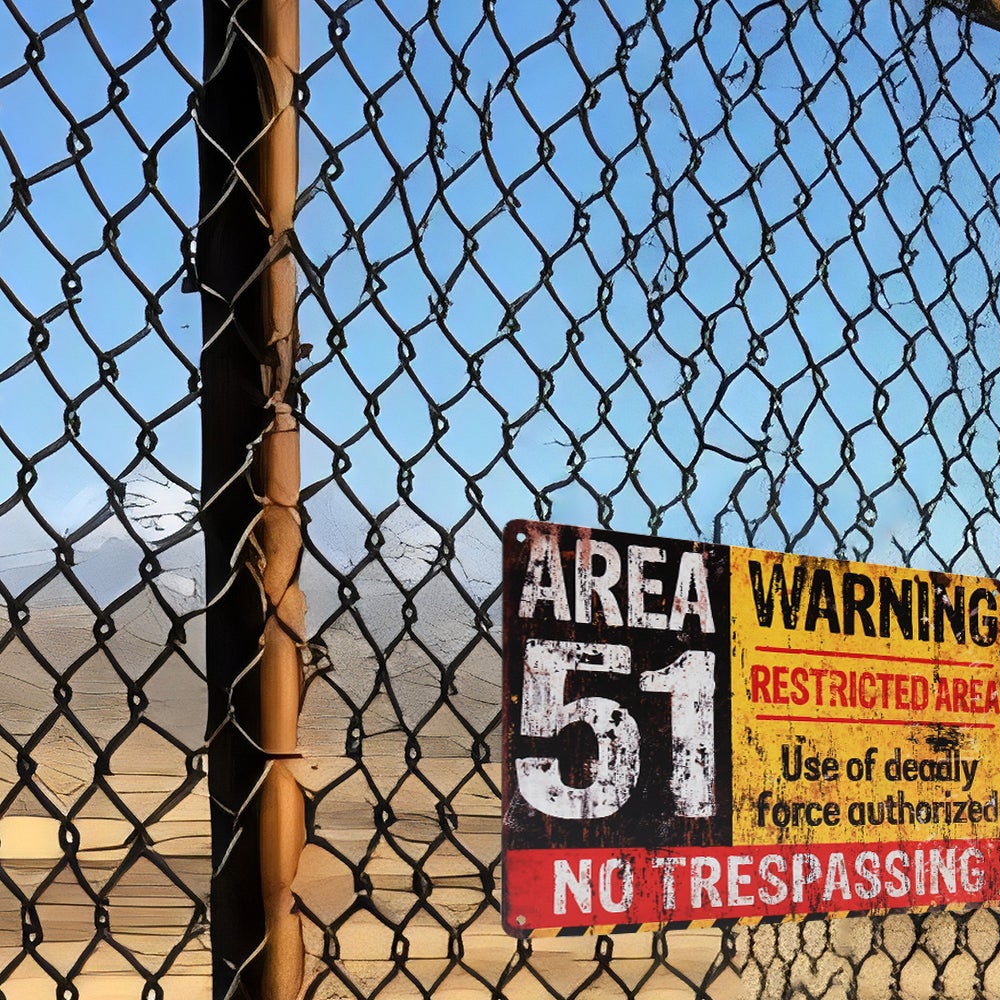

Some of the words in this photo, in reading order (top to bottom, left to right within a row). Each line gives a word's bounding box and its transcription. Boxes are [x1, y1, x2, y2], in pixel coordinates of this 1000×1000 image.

[518, 534, 716, 633] AREA
[748, 560, 998, 647] WARNING
[751, 665, 928, 711] RESTRICTED
[935, 677, 1000, 714] AREA
[515, 638, 717, 819] 51
[781, 744, 839, 782] Use
[846, 747, 878, 782] of
[884, 747, 979, 791] deadly
[757, 791, 841, 827] force
[847, 790, 998, 827] authorized
[553, 857, 634, 915] NO
[651, 847, 986, 910] TRESPASSING
